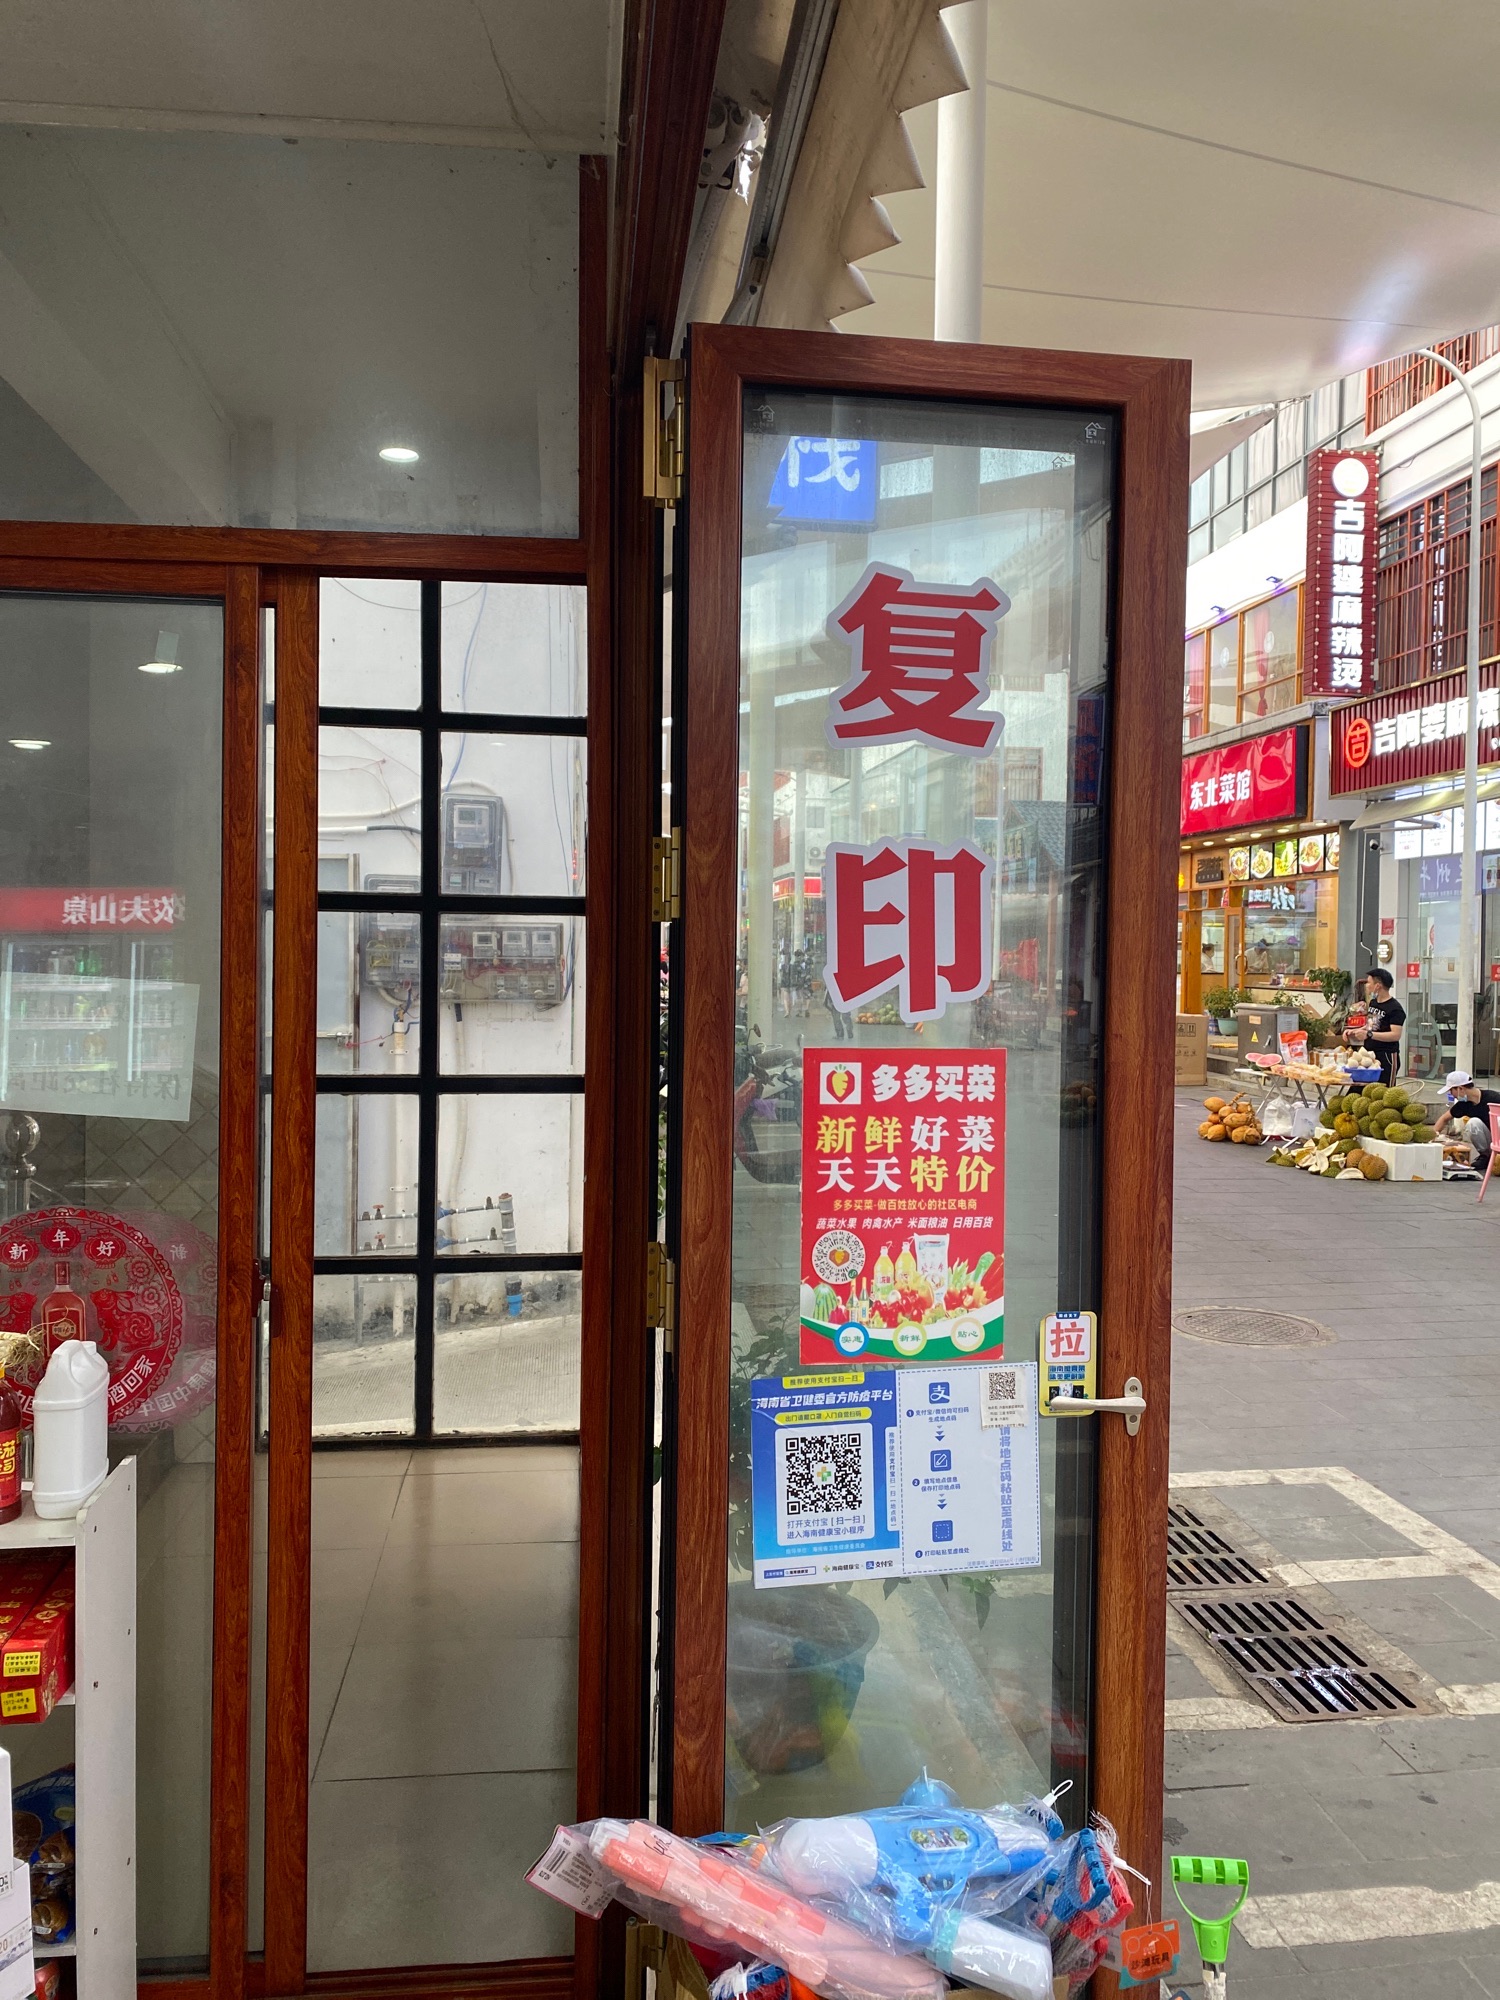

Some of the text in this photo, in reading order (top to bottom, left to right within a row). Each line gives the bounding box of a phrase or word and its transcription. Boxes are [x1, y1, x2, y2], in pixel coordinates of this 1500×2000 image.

[1189, 769, 1251, 812] 东北菜馆
[871, 1064, 996, 1103] 多多买菜
[815, 1115, 996, 1154] 新鲜好菜
[816, 1155, 996, 1193] 天天特价
[815, 1216, 994, 1230] 蔬菜水果 肉禽水产 米面粮油 日用百货
[833, 1198, 977, 1212] 多多买菜-做百姓放心的社区电商
[1050, 1321, 1085, 1358] 拉
[756, 1389, 894, 1409] 海南省卫健委官方防疫平台
[786, 1525, 865, 1540] 进入海南健康宝小程序
